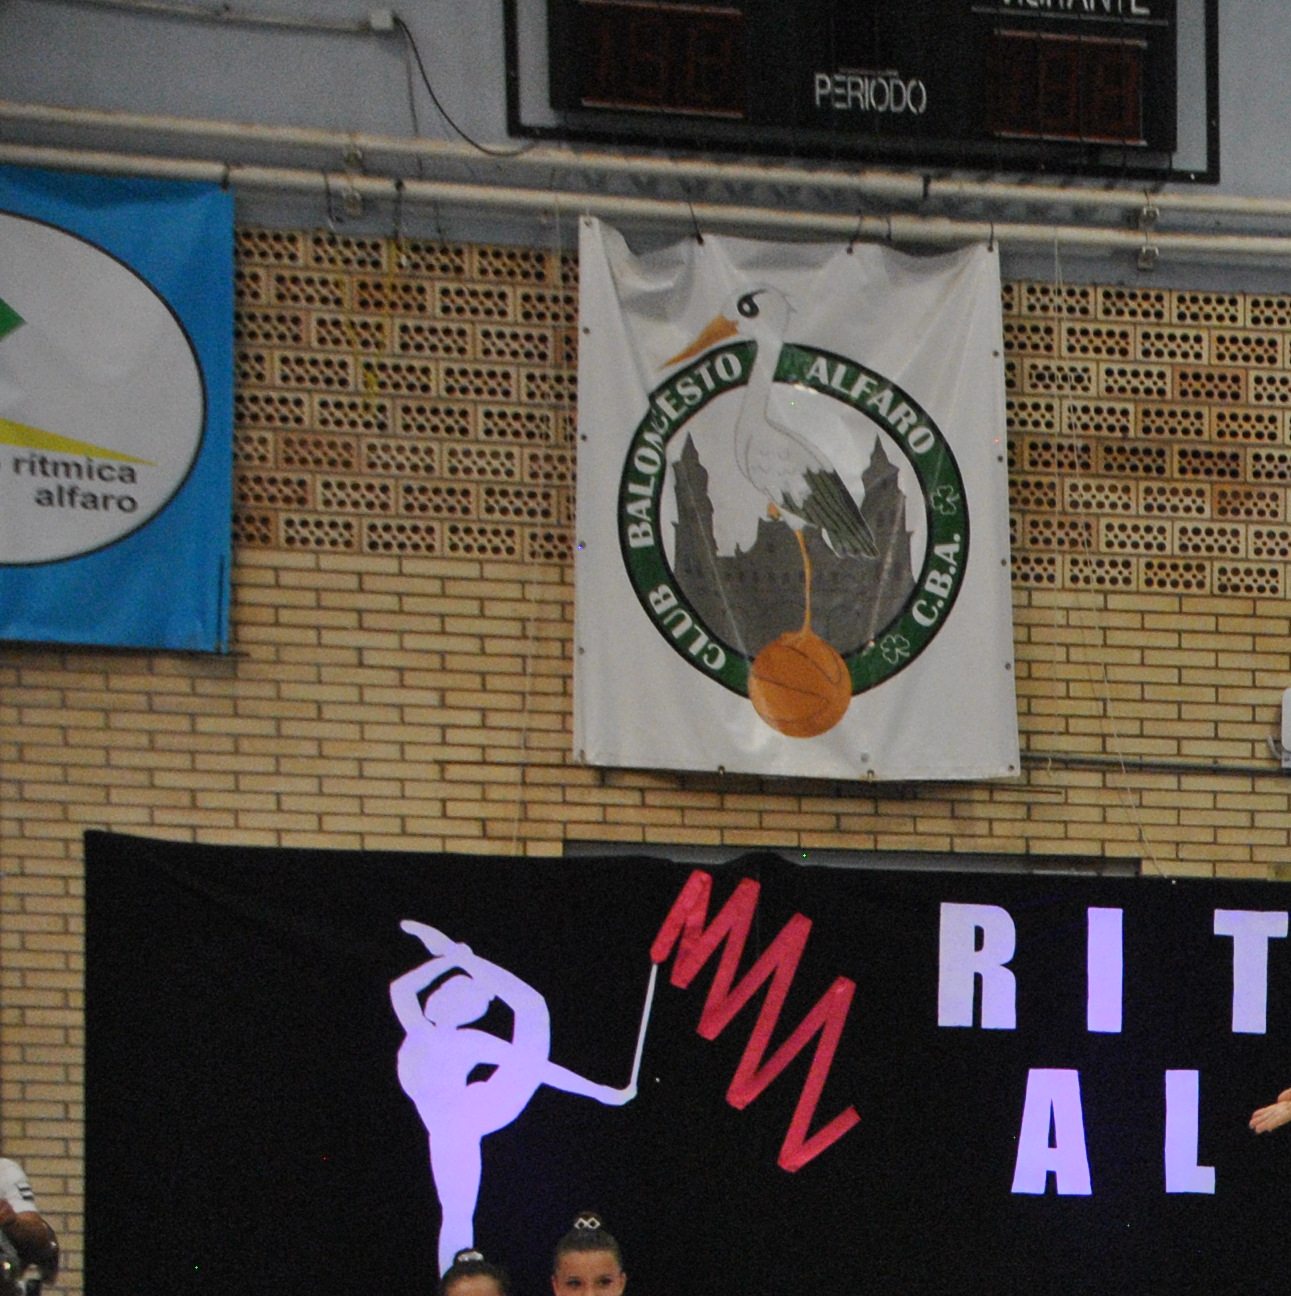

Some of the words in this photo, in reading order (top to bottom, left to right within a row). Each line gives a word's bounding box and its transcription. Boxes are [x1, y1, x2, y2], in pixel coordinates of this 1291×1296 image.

[814, 72, 927, 115] PERIODO
[628, 350, 743, 549] BALONCESTO
[807, 356, 934, 456] ALFARO
[35, 485, 138, 513] alfaro
[647, 582, 727, 671] CLUB
[911, 533, 962, 629] C.B.A.
